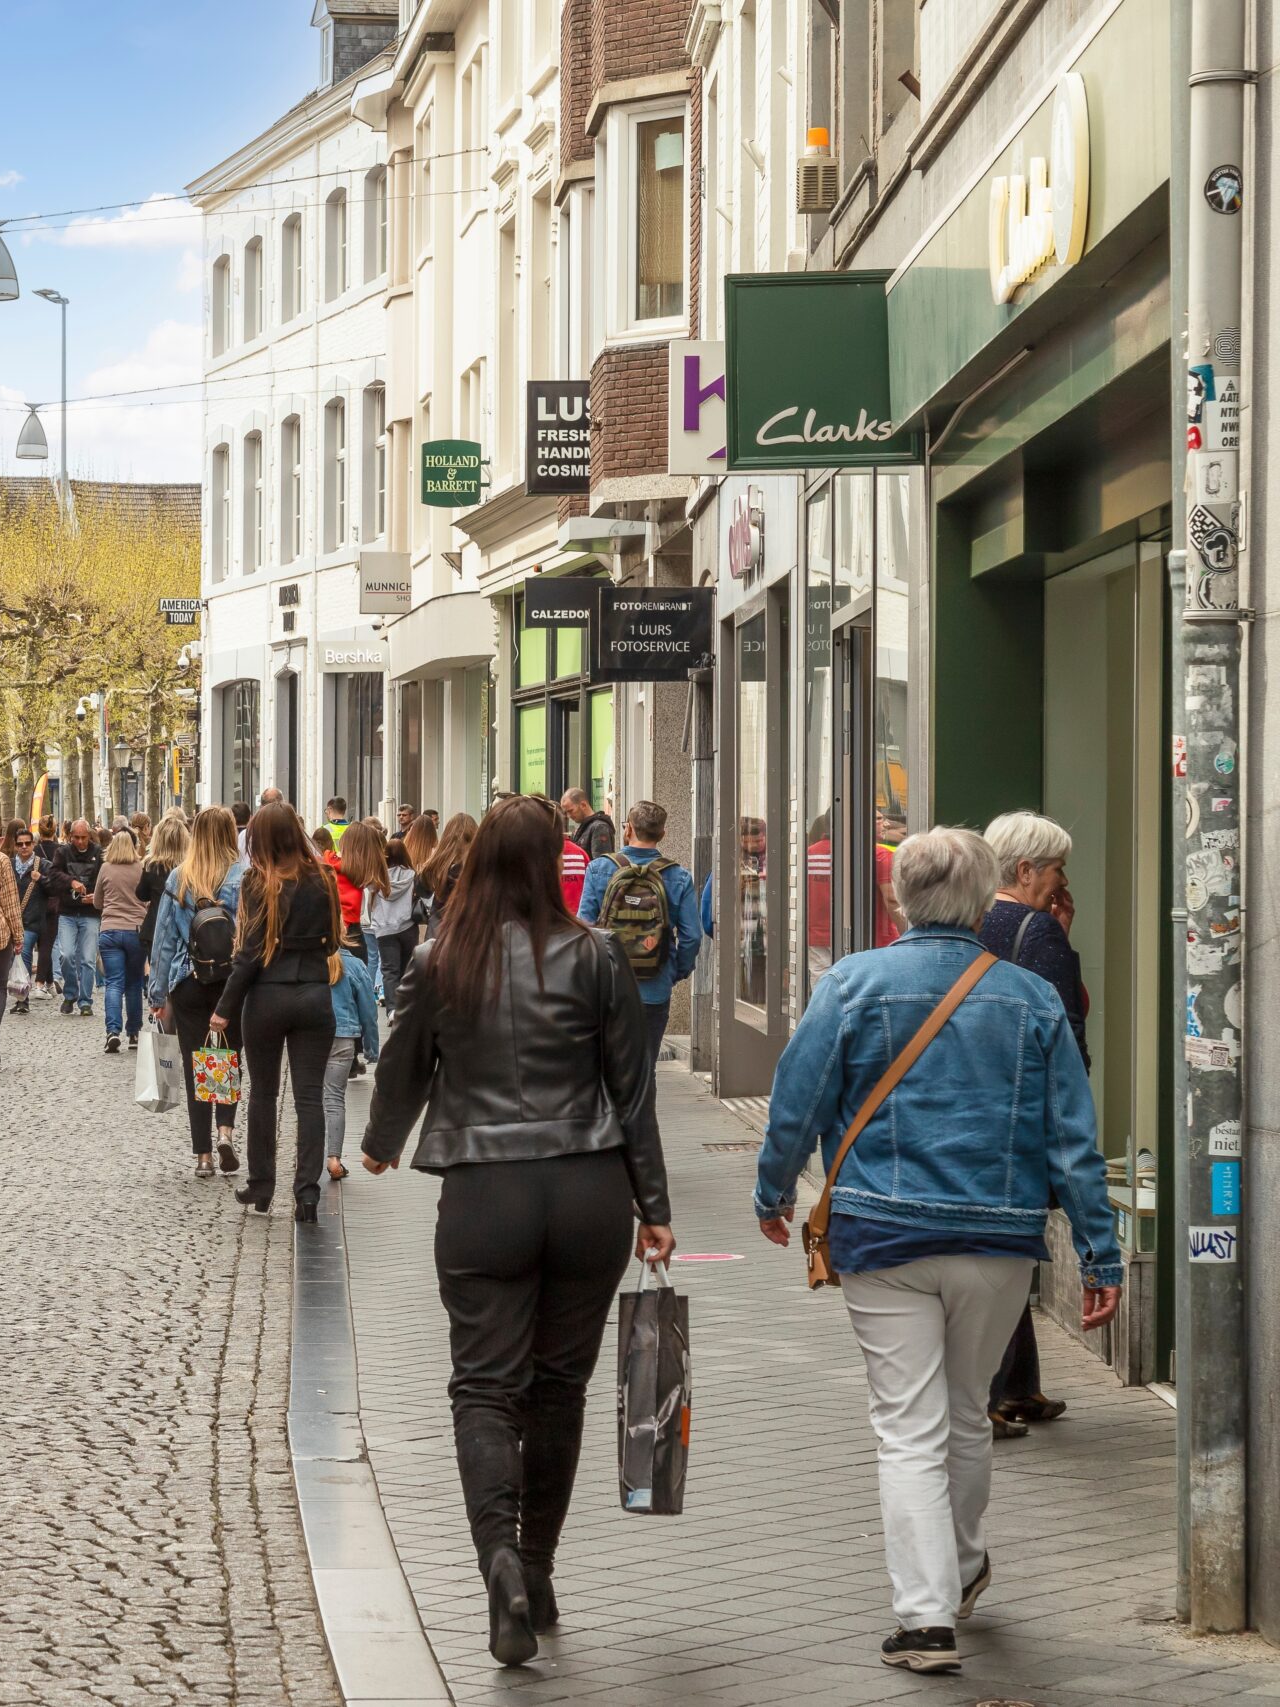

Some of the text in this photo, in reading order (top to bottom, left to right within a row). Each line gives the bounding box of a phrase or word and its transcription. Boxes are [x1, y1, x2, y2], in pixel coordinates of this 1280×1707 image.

[537, 396, 590, 422] LU
[756, 406, 892, 445] Clarks
[538, 430, 590, 441] FRESH
[426, 456, 479, 467] HOLLAND
[447, 468, 457, 479] &
[427, 480, 477, 492] BARRETT
[162, 601, 201, 610] AMERICA
[170, 612, 193, 623] TODAY
[630, 625, 672, 636] 1 UURS
[611, 641, 690, 652] FOTOSERVICE
[325, 650, 382, 664] Bershka
